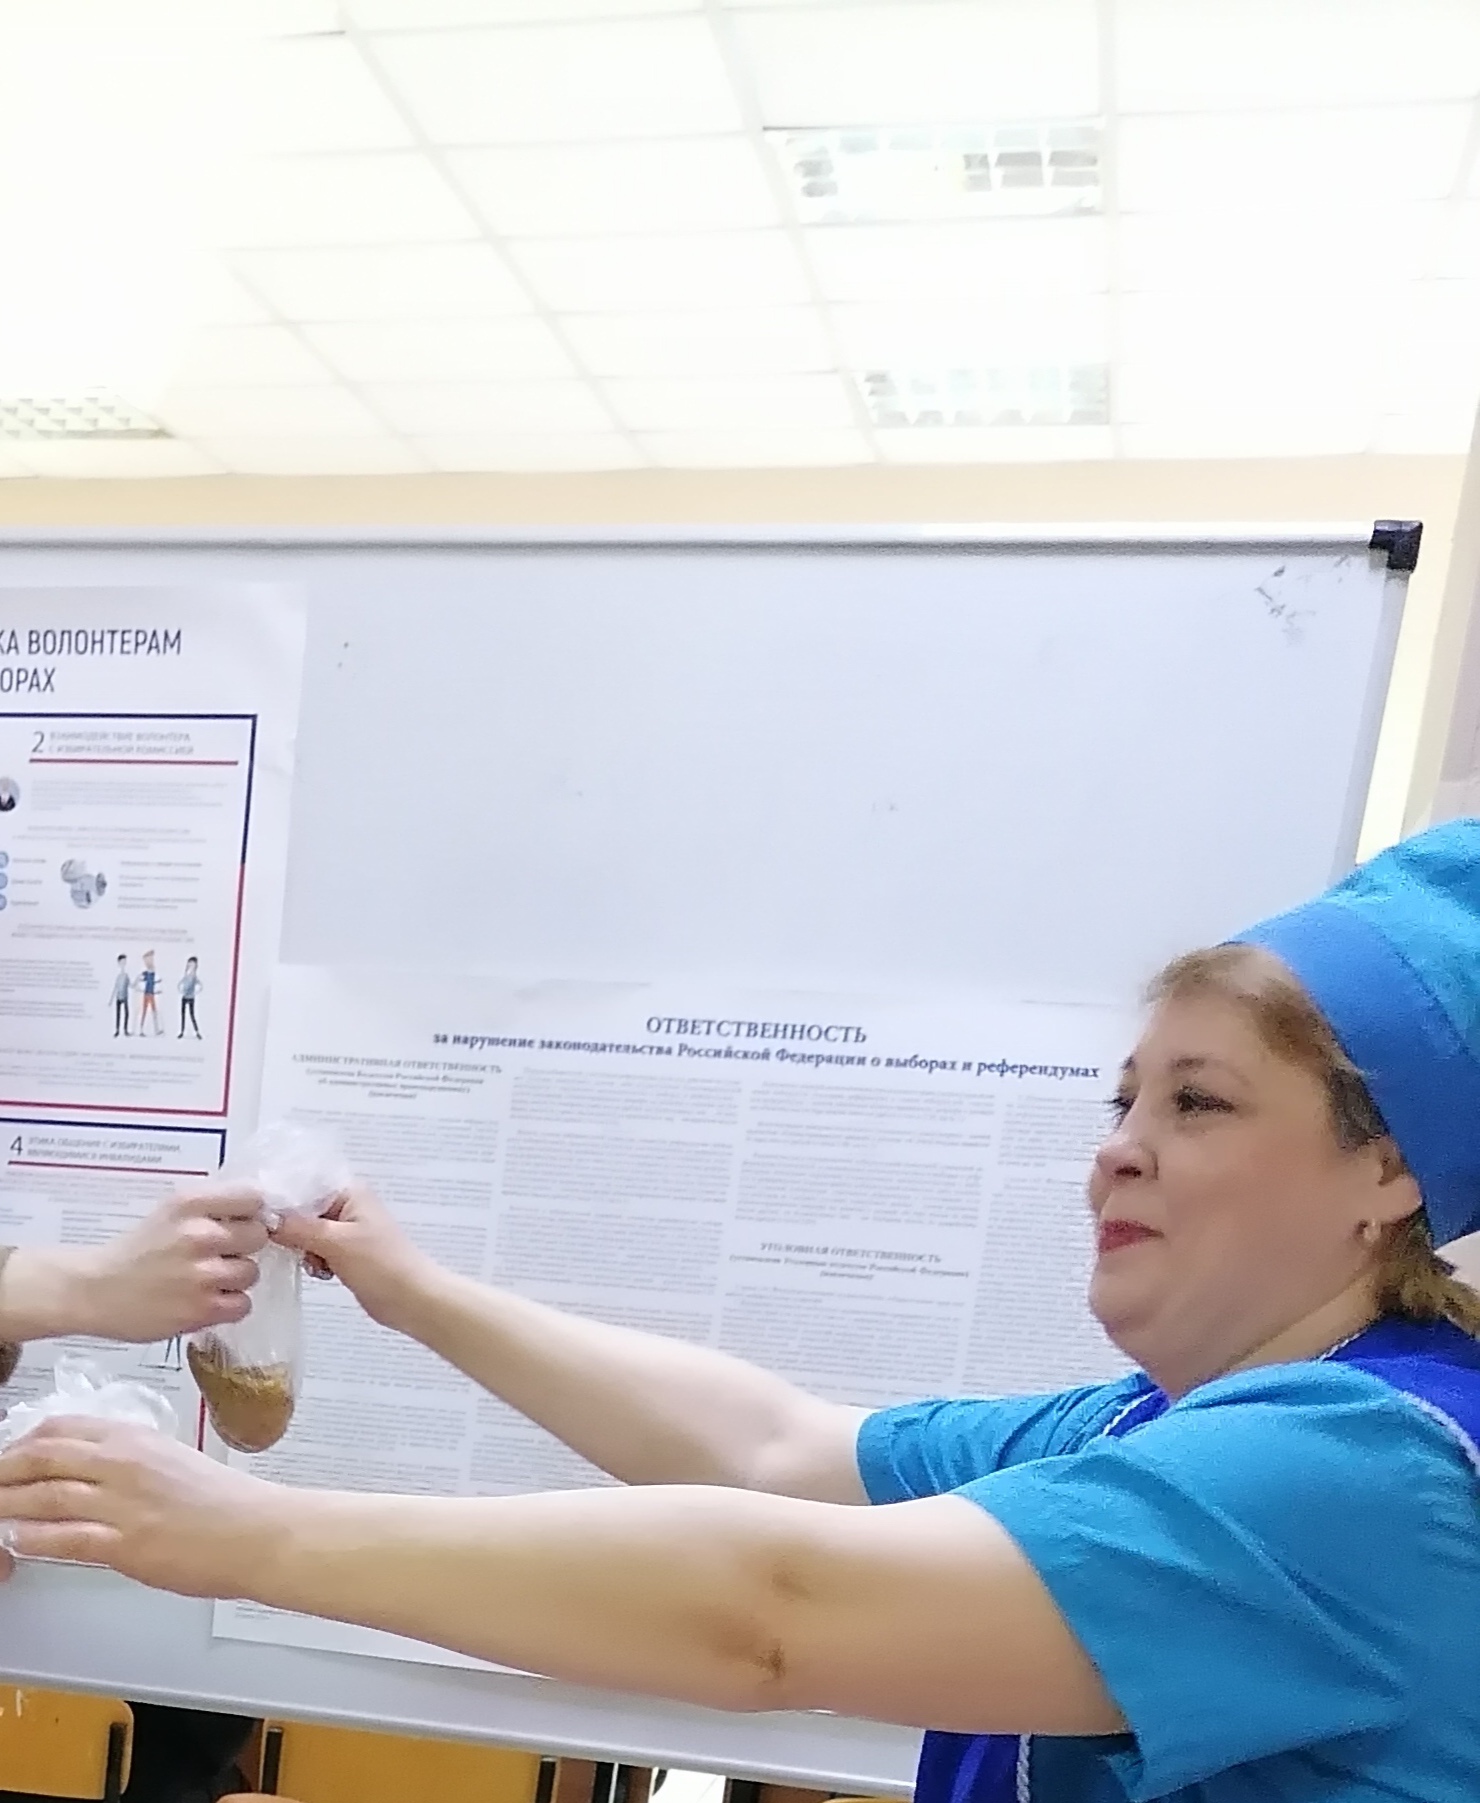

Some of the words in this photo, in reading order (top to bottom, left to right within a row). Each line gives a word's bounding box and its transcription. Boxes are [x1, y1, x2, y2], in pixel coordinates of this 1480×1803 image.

[27, 629, 182, 655] ВОЛОНТЕРАМ
[31, 730, 45, 754] 2
[646, 1016, 868, 1044] ОТВЕТСТВЕННОСТЬ
[433, 1032, 449, 1044] за
[452, 1034, 535, 1051] нарушение
[538, 1038, 672, 1057] законодательства
[678, 1043, 771, 1061] Российской
[776, 1048, 867, 1068] Федерации
[871, 1056, 881, 1068] о
[884, 1054, 958, 1073] выборах
[961, 1062, 972, 1073] и
[977, 1058, 1100, 1081] референдумах
[10, 1135, 23, 1156] 4
